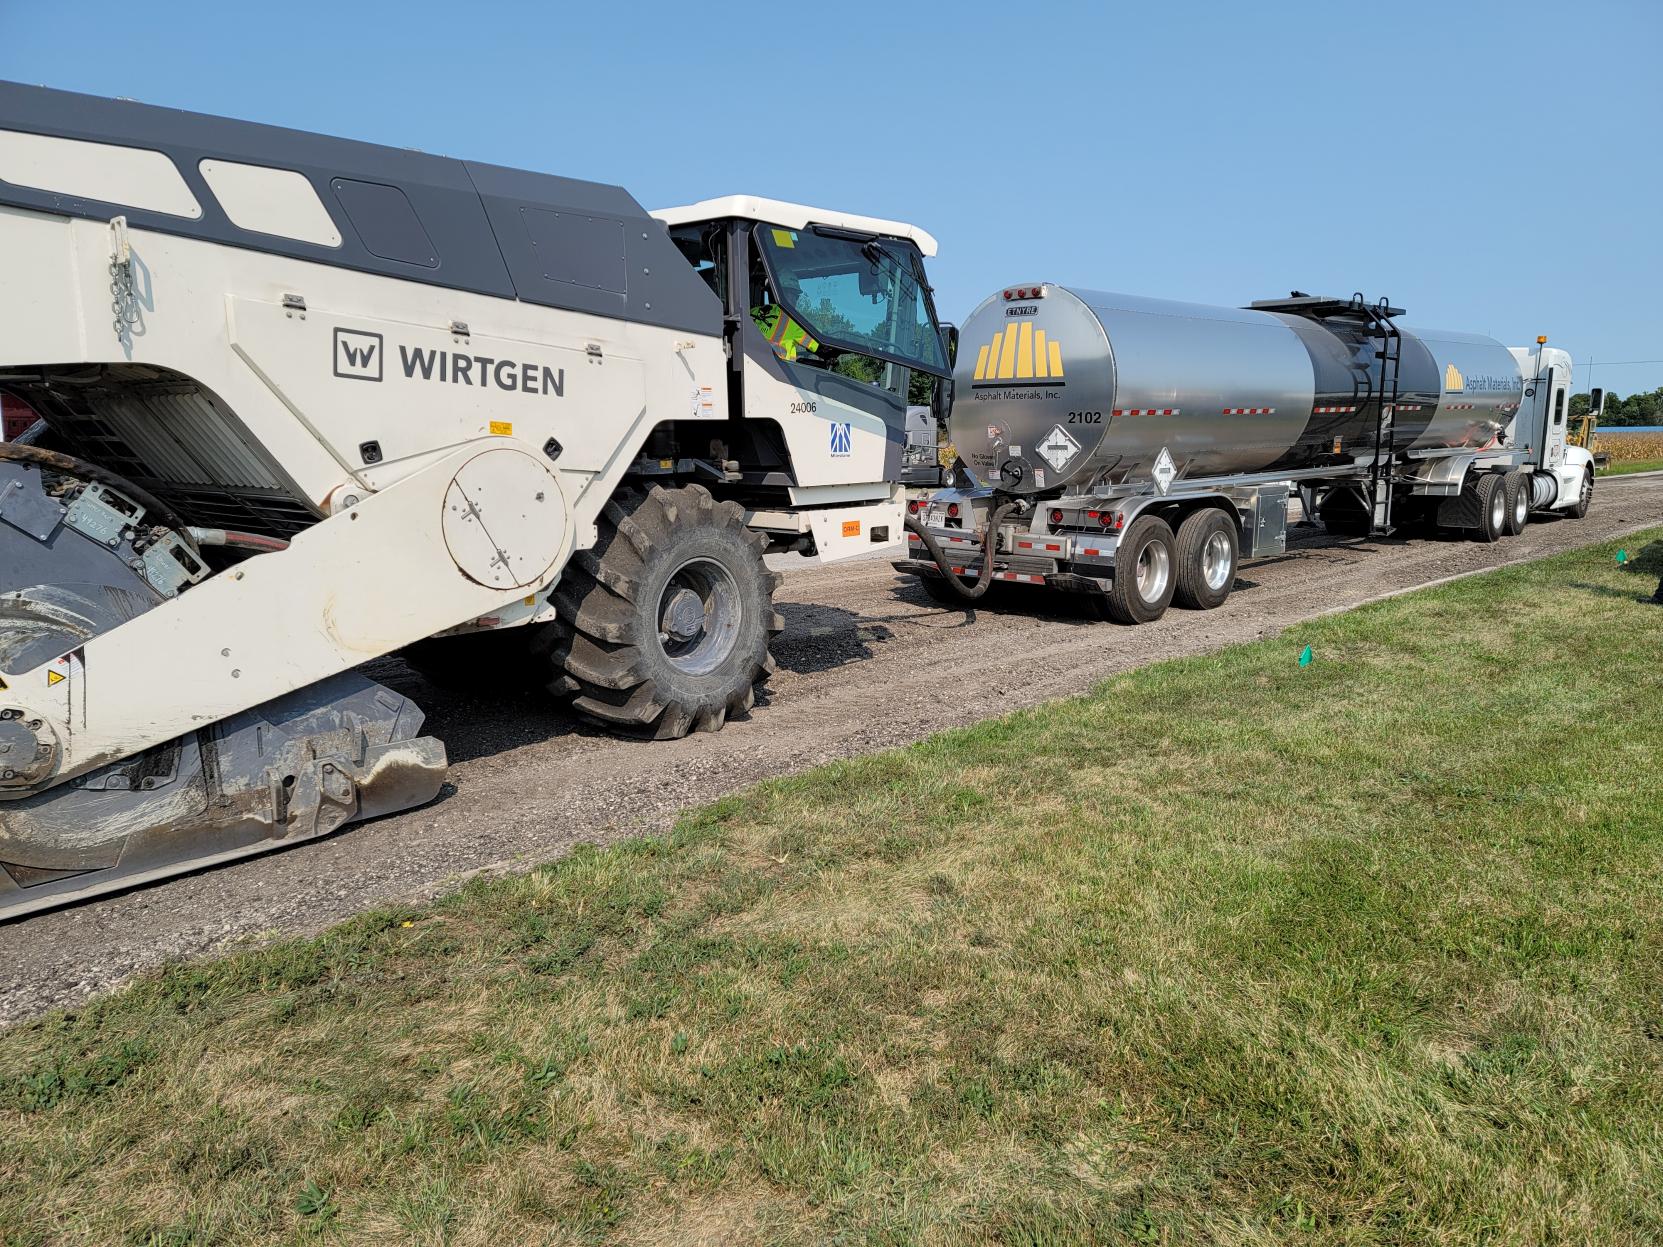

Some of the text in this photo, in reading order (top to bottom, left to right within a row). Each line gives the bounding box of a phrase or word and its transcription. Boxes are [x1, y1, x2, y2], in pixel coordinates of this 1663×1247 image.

[1006, 306, 1038, 317] ETNYRE
[398, 344, 565, 397] WIRTGEN
[1465, 375, 1486, 394] Asphalt
[1487, 375, 1511, 392] Materials,
[974, 389, 1061, 402] Asphalt Materials, Inc.
[790, 401, 817, 414] 24006
[1068, 411, 1102, 424] 2102
